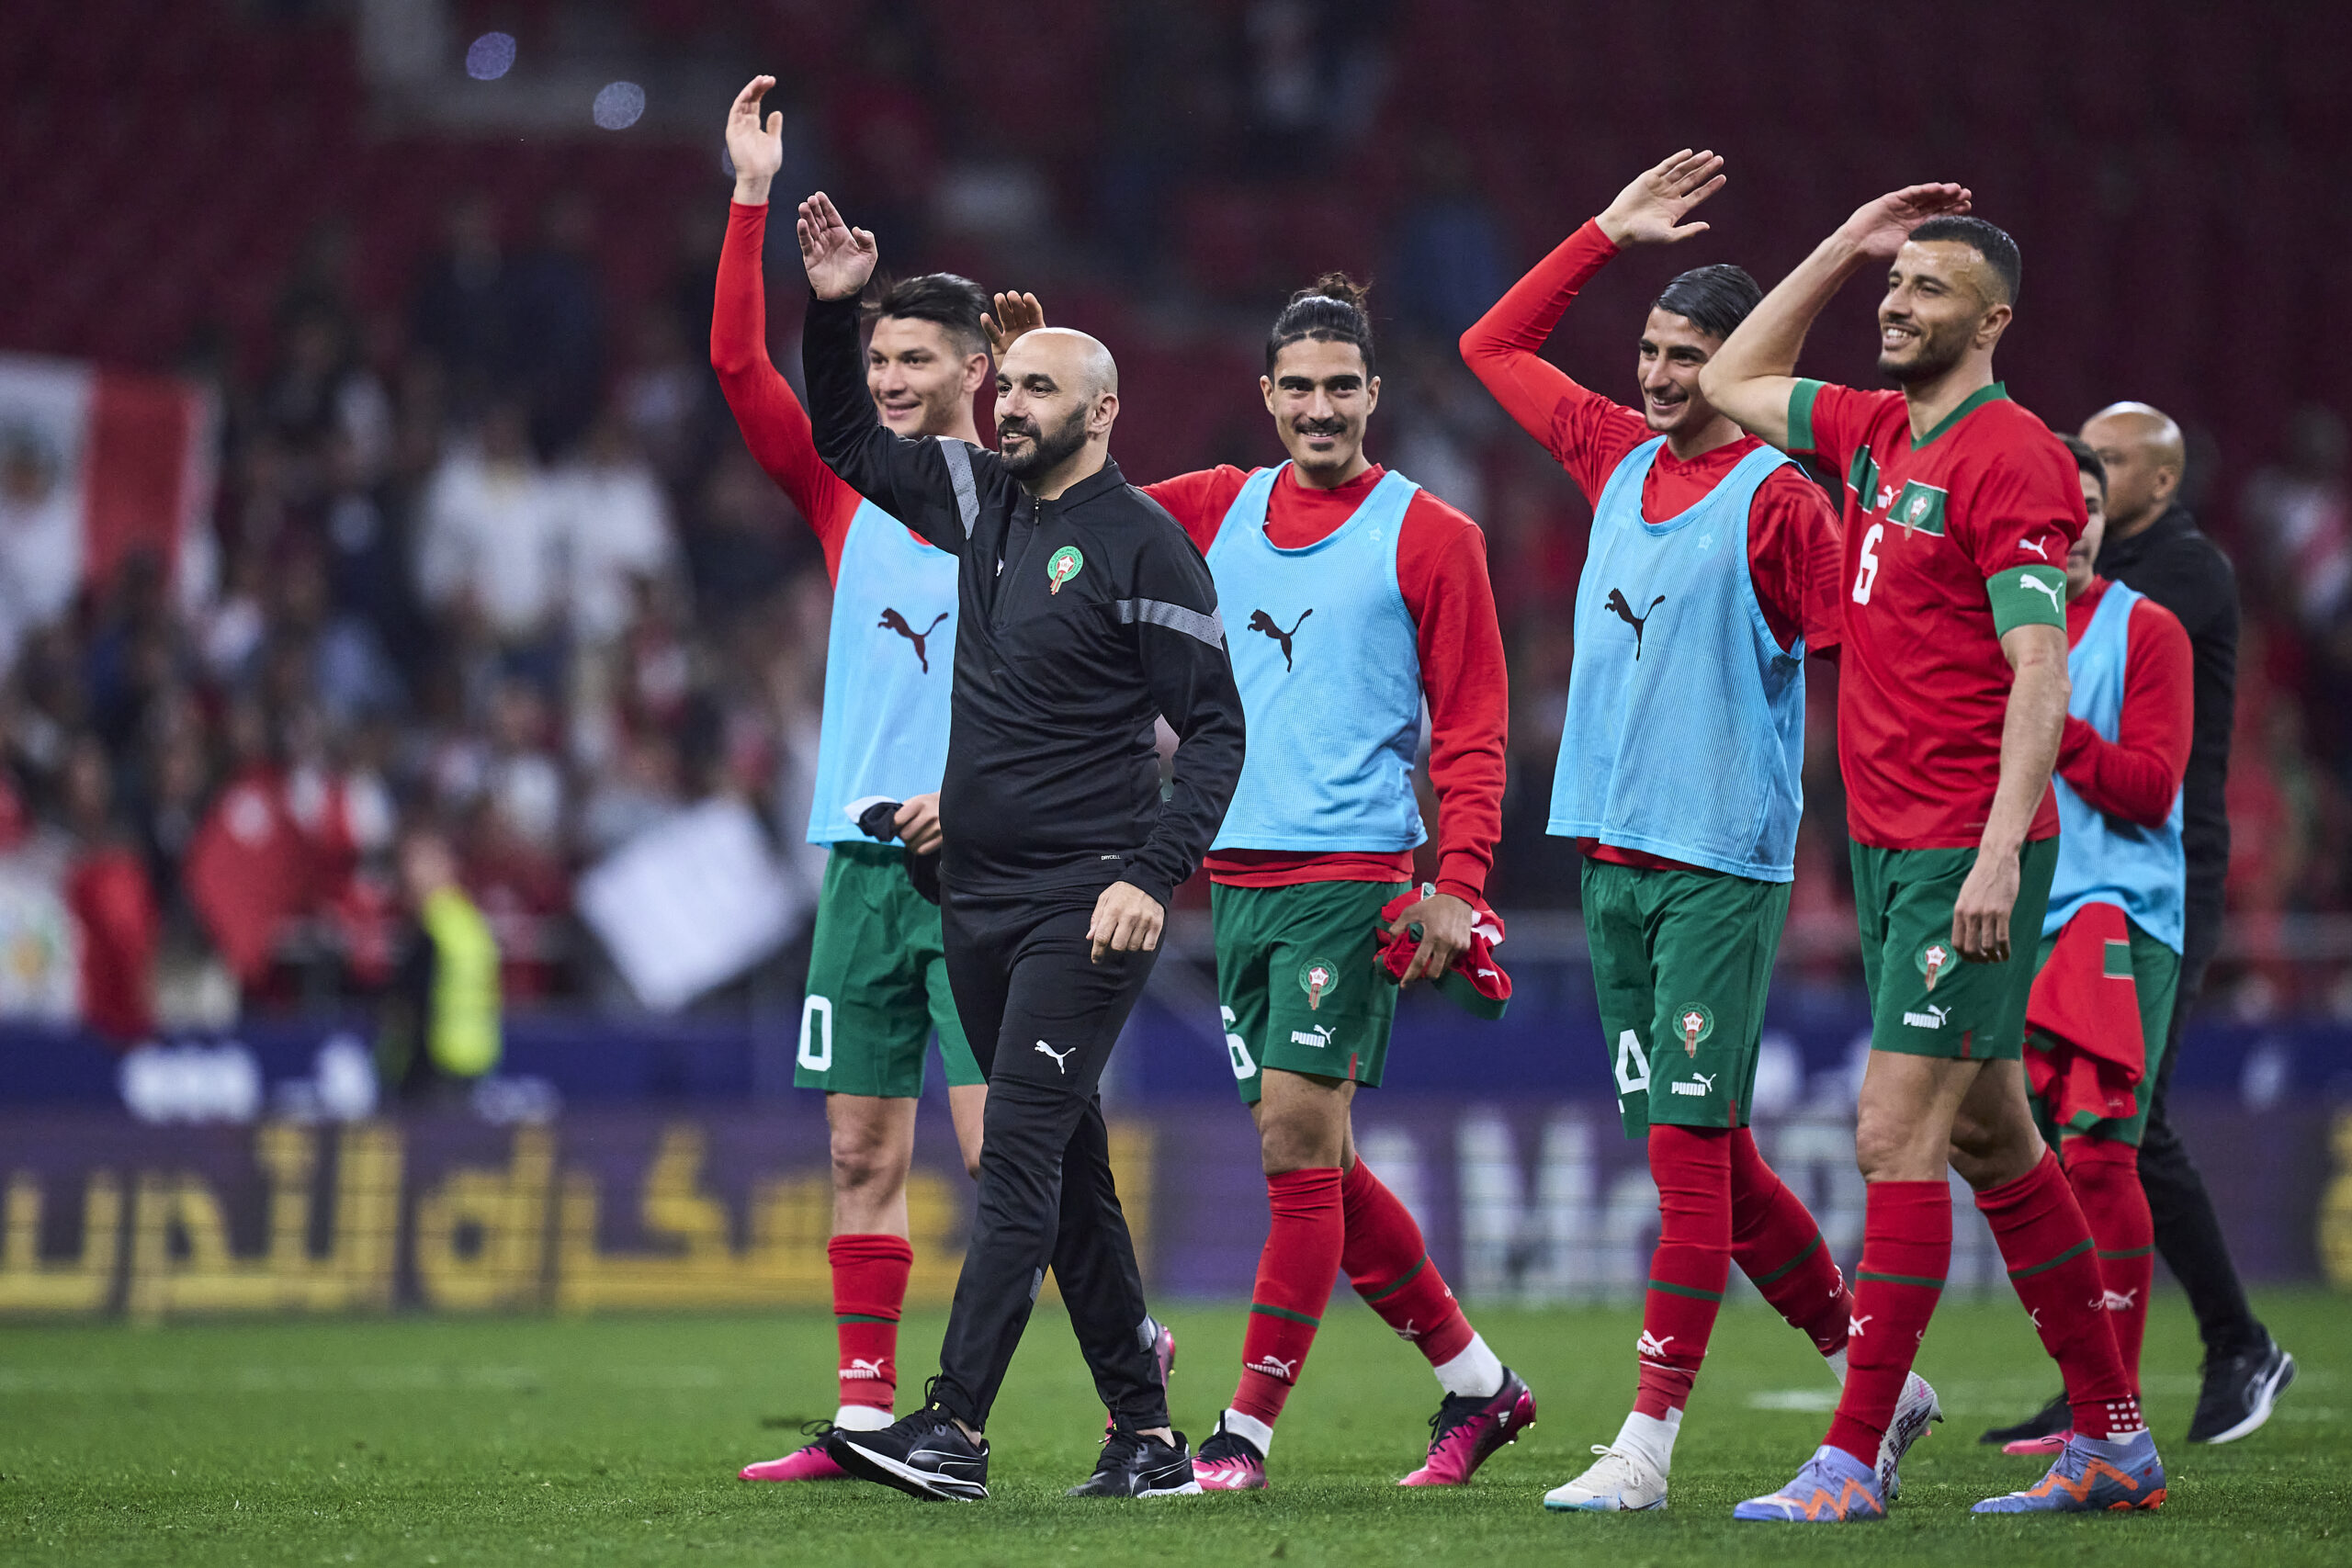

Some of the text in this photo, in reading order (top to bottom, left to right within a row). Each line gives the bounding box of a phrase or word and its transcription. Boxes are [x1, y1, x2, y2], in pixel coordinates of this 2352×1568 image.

[1852, 523, 1884, 606] 6
[1903, 1011, 1940, 1030] PUMA
[797, 994, 832, 1072] 0
[1220, 1005, 1258, 1080] 6
[1291, 1031, 1326, 1048] PUMA
[1671, 1081, 1706, 1097] PUMA
[839, 1368, 875, 1380] PUMA
